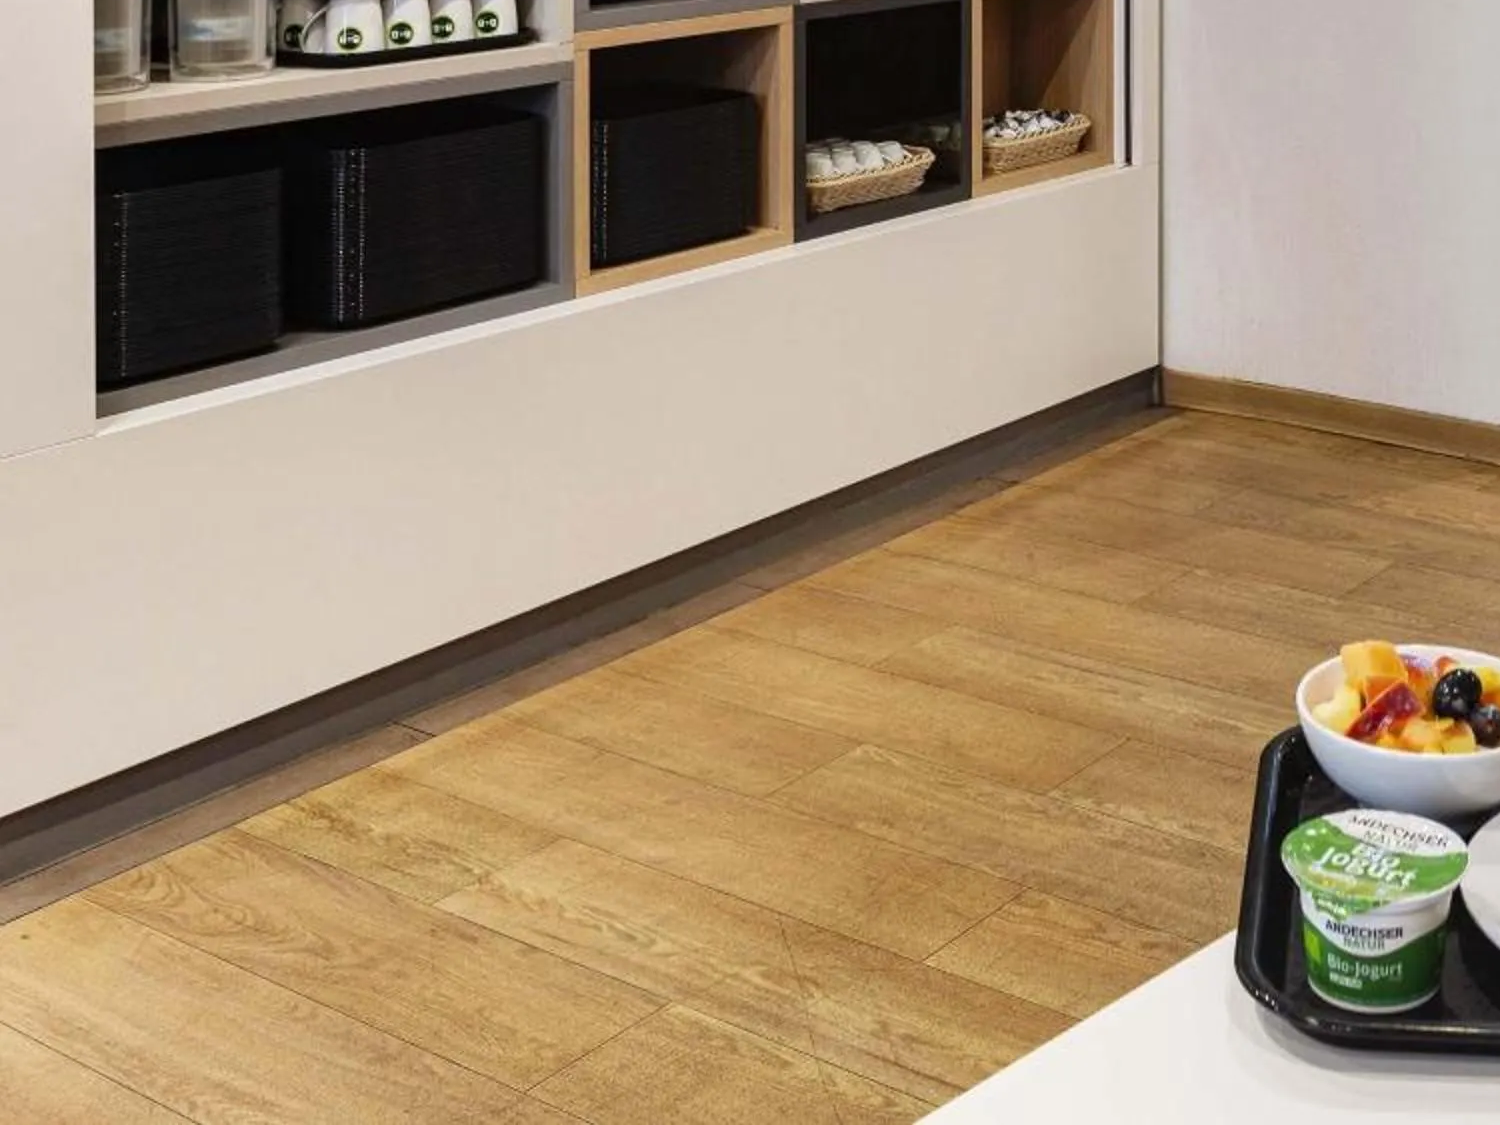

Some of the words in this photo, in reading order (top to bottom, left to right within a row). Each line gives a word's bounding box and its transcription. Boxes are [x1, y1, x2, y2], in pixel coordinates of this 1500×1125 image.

[1325, 919, 1404, 939] ANDECHSER
[1343, 935, 1386, 951] NATUR
[1327, 953, 1403, 980] Bio-Jogurt
